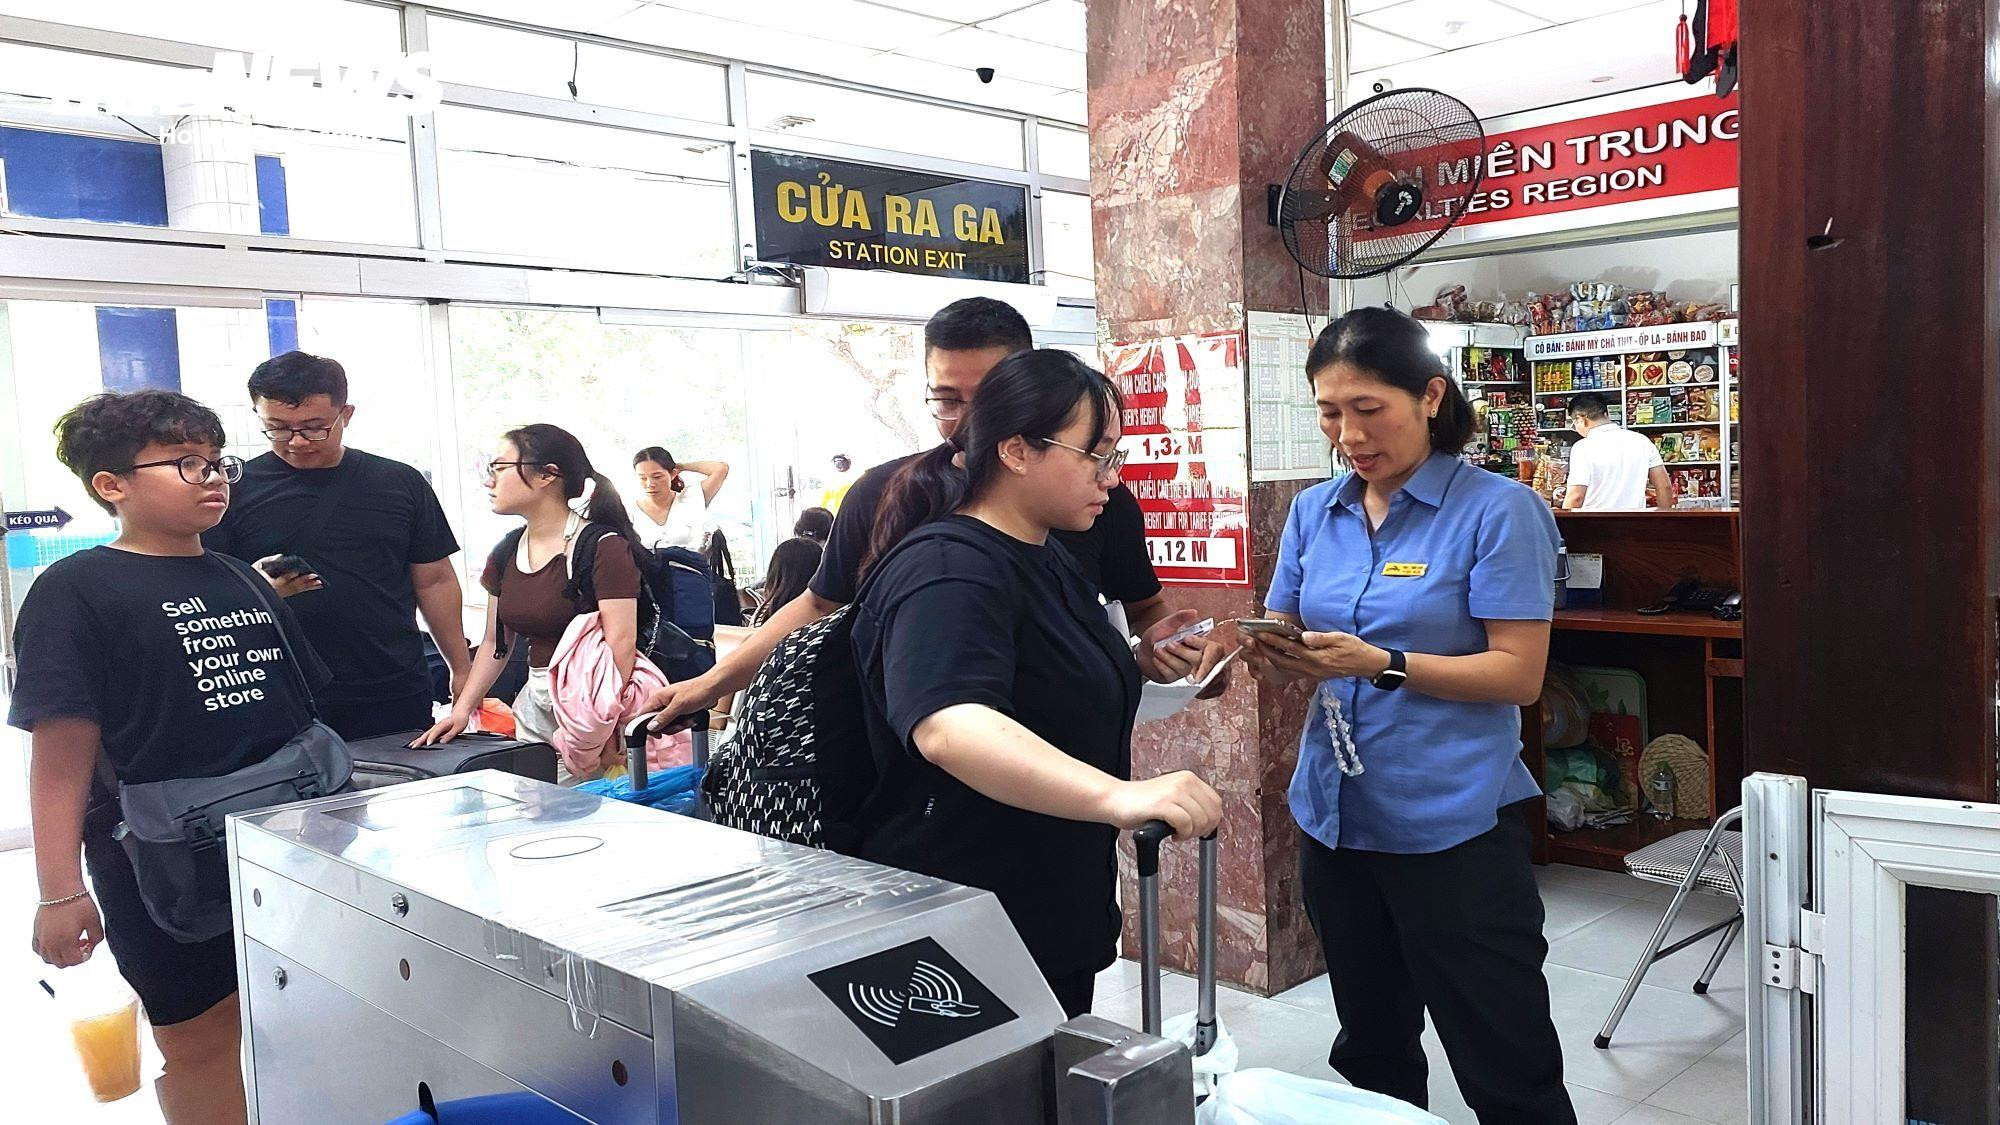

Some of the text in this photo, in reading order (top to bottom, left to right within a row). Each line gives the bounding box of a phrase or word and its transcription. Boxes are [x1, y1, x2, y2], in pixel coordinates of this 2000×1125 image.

[1438, 141, 1552, 186] MIỀN
[1566, 110, 1739, 164] TRUNG
[1523, 165, 1663, 205] REGION
[777, 172, 1004, 245] CỬA RA GA
[829, 240, 966, 270] STATION EXIT
[1565, 338, 1585, 351] BÁNH
[1651, 334, 1660, 345] LA
[1666, 330, 1688, 344] BÁNH
[1691, 329, 1706, 342] BAO
[1139, 406, 1158, 425] HEIGHT
[1188, 435, 1202, 454] M
[9, 514, 59, 525] KÉO QUA
[1163, 512, 1177, 529] LIMIT
[1178, 512, 1189, 529] FOR
[1189, 512, 1208, 529] TARIFF
[1147, 540, 1208, 563] 1,12 M
[161, 597, 207, 617] Sell
[182, 634, 236, 654] from
[188, 647, 283, 677] your own
[197, 668, 266, 692] online
[204, 688, 264, 711] store
